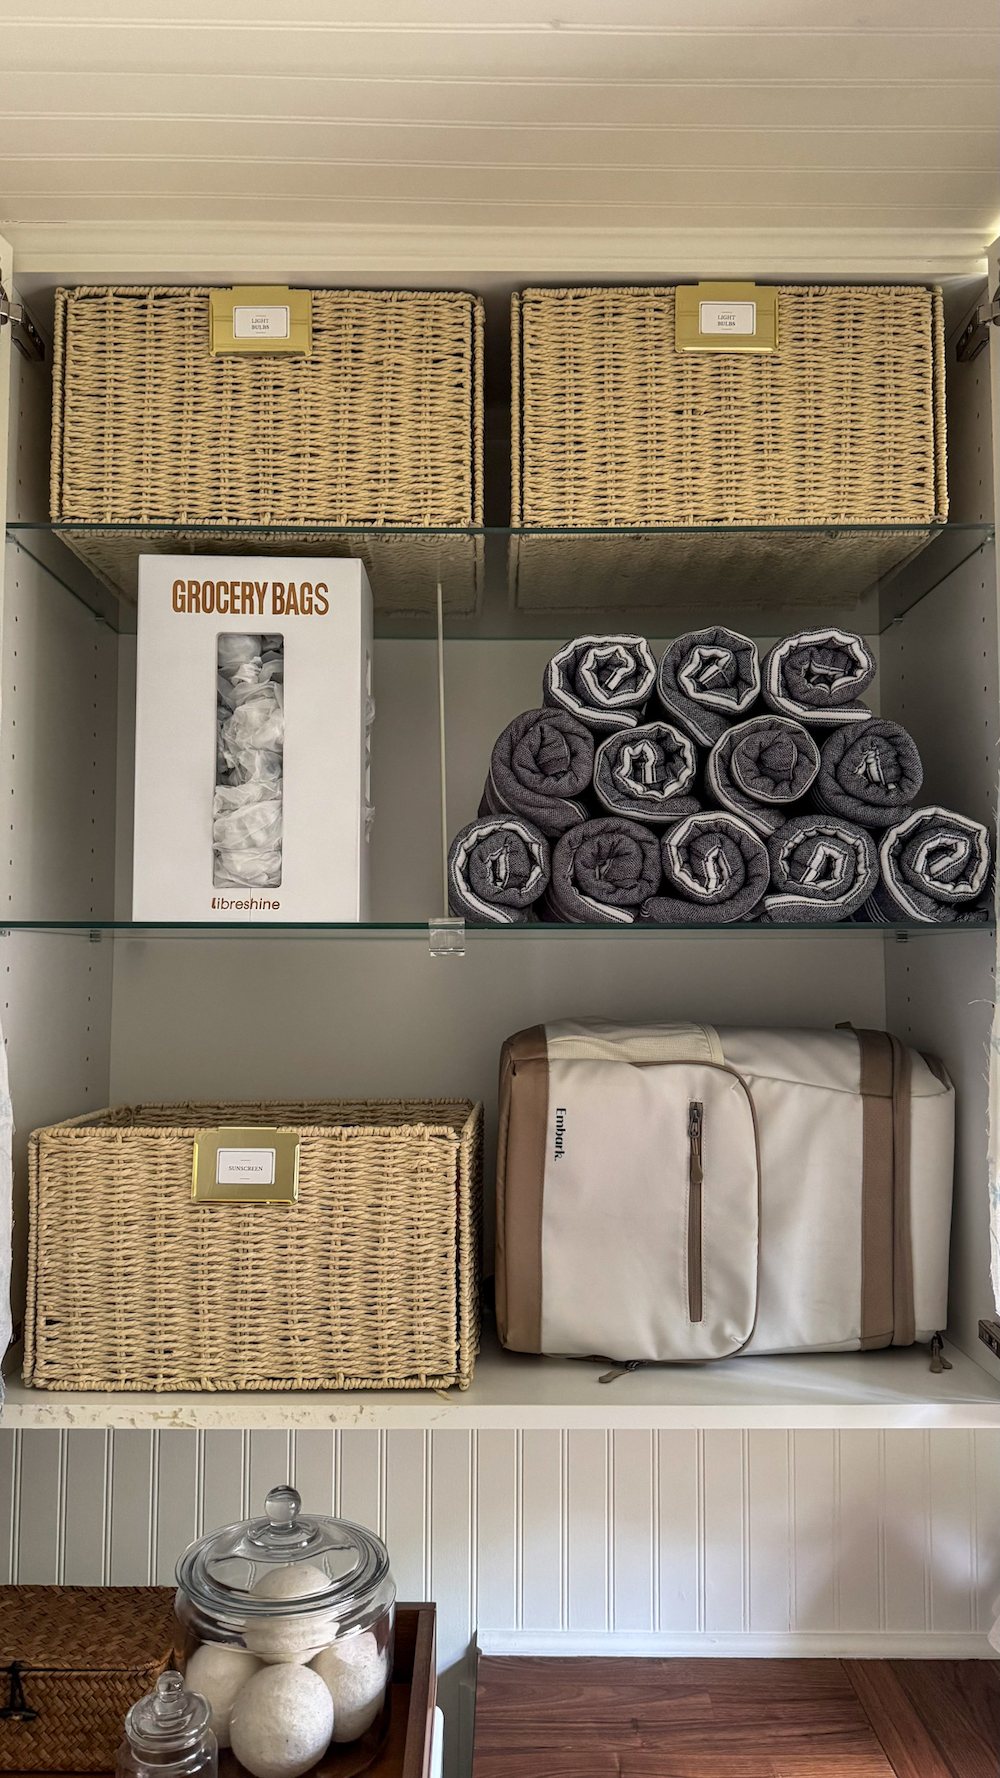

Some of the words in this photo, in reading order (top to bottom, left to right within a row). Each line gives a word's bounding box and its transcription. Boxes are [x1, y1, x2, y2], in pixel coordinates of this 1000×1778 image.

[172, 579, 268, 615] GROCERY
[271, 582, 330, 616] BAGS
[211, 897, 280, 910] libreshine
